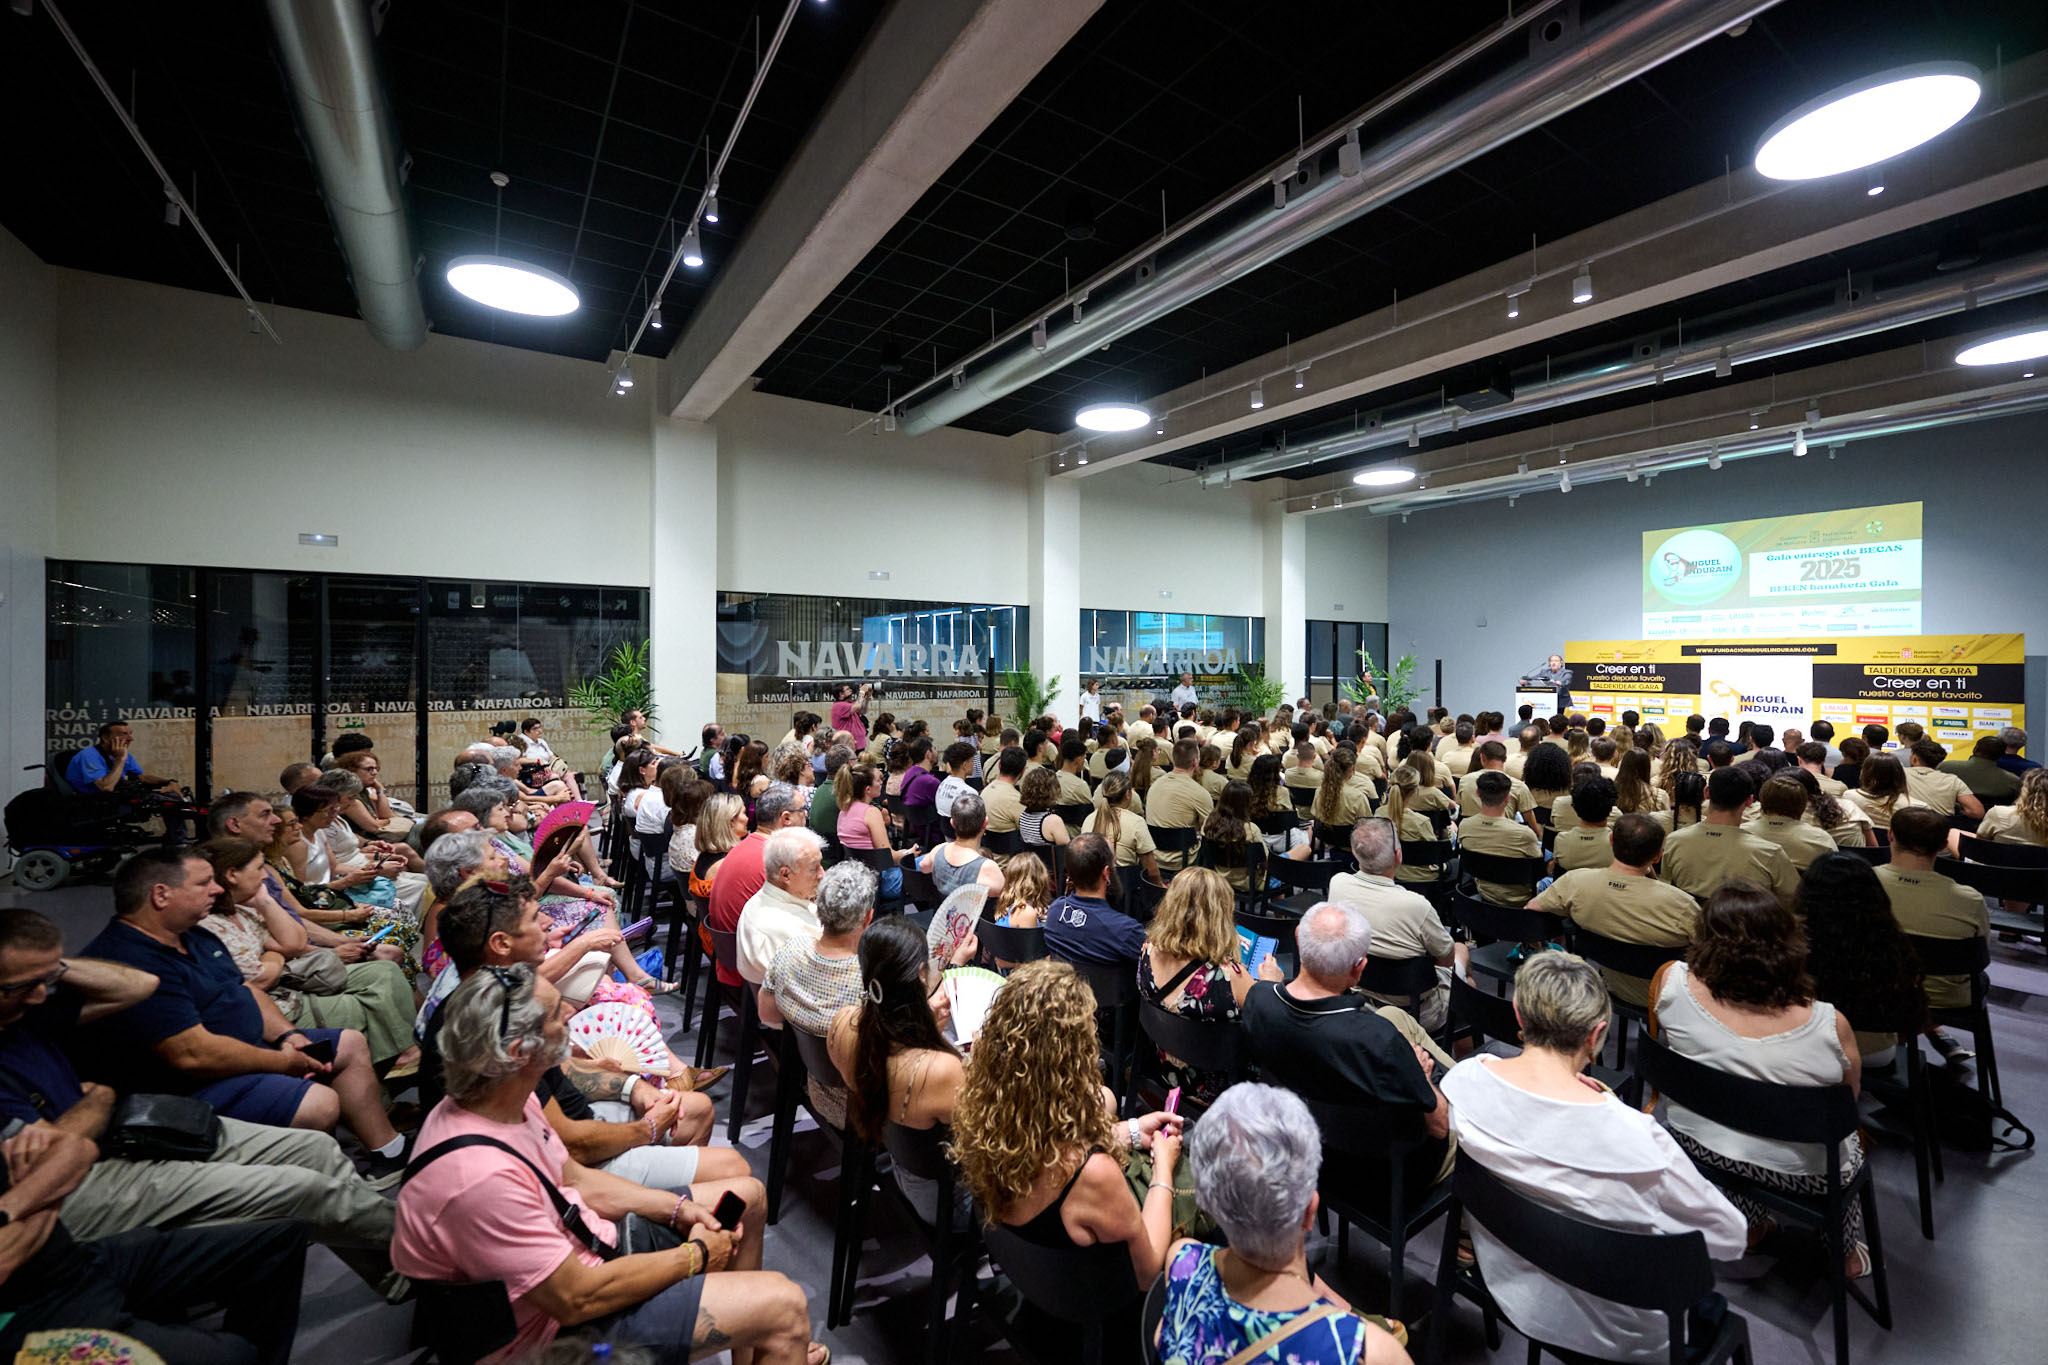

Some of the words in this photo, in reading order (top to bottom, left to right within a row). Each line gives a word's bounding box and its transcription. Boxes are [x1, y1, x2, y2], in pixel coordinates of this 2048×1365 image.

[1800, 557, 1861, 582] 2025
[776, 640, 986, 677] NAVARRA
[1089, 646, 1242, 675] NAFARROA
[1596, 664, 1627, 675] Creer
[1630, 666, 1645, 675] en
[1648, 664, 1656, 674] ti
[1868, 667, 1936, 675] TALDEKIDEAK
[1939, 667, 1973, 675] GARA
[1611, 675, 1639, 683] deporte
[1639, 674, 1666, 682] favorito
[1873, 676, 1921, 689] Creer
[1926, 678, 1951, 690] en
[1955, 676, 1967, 690] ti
[1740, 695, 1787, 704] MIGUEL
[1859, 690, 1895, 698] nuestro
[1897, 690, 1940, 700] deporte
[1942, 691, 1983, 700] favorito
[474, 697, 552, 710] NAFARROA
[1740, 704, 1804, 714] INDURAIN
